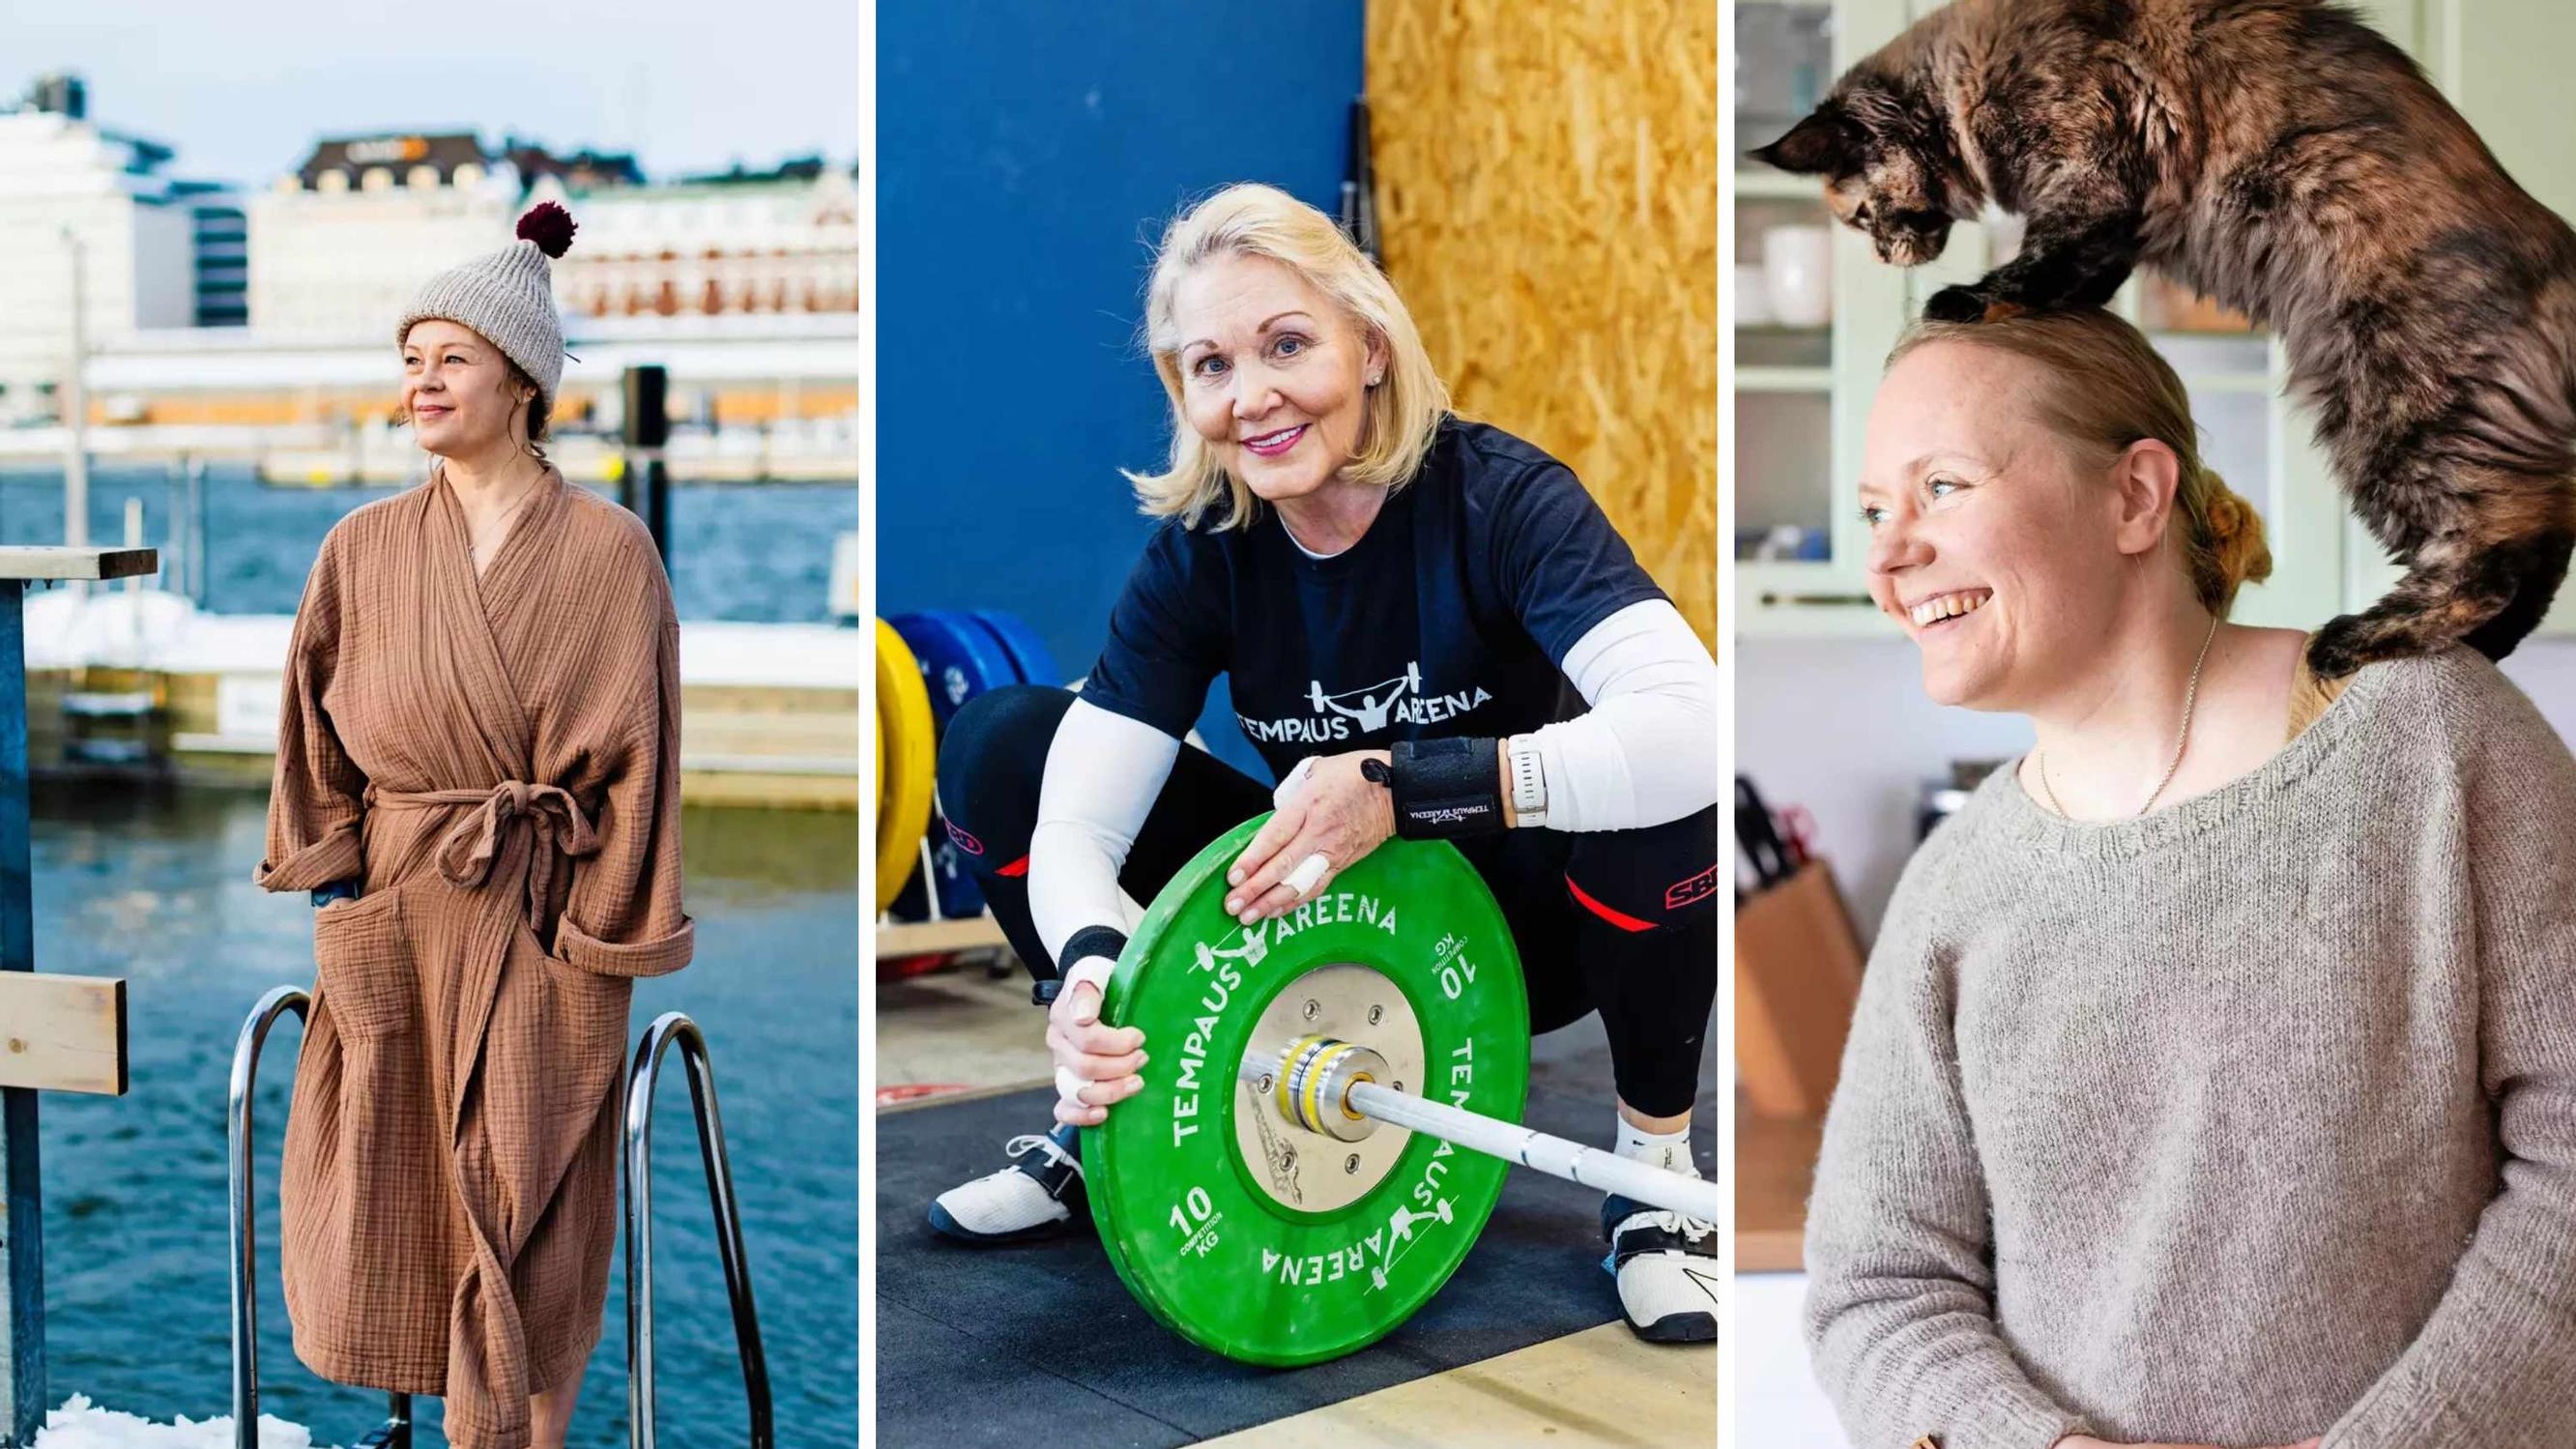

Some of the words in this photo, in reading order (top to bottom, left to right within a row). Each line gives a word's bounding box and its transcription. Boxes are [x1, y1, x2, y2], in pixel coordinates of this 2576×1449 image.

[1235, 711, 1349, 742] TEMPAUS
[1395, 686, 1492, 725] AREENA
[1434, 932, 1455, 956] KG
[1441, 953, 1476, 1000] 10
[1173, 963, 1241, 1147] TEMPAUS
[1276, 893, 1395, 945] AREENA
[1414, 1037, 1472, 1207] TEMAUS
[1169, 1186, 1212, 1237] 10
[1180, 1211, 1223, 1257] COMPETITION
[1196, 1231, 1219, 1258] KG
[1262, 1228, 1382, 1286] AREENA
